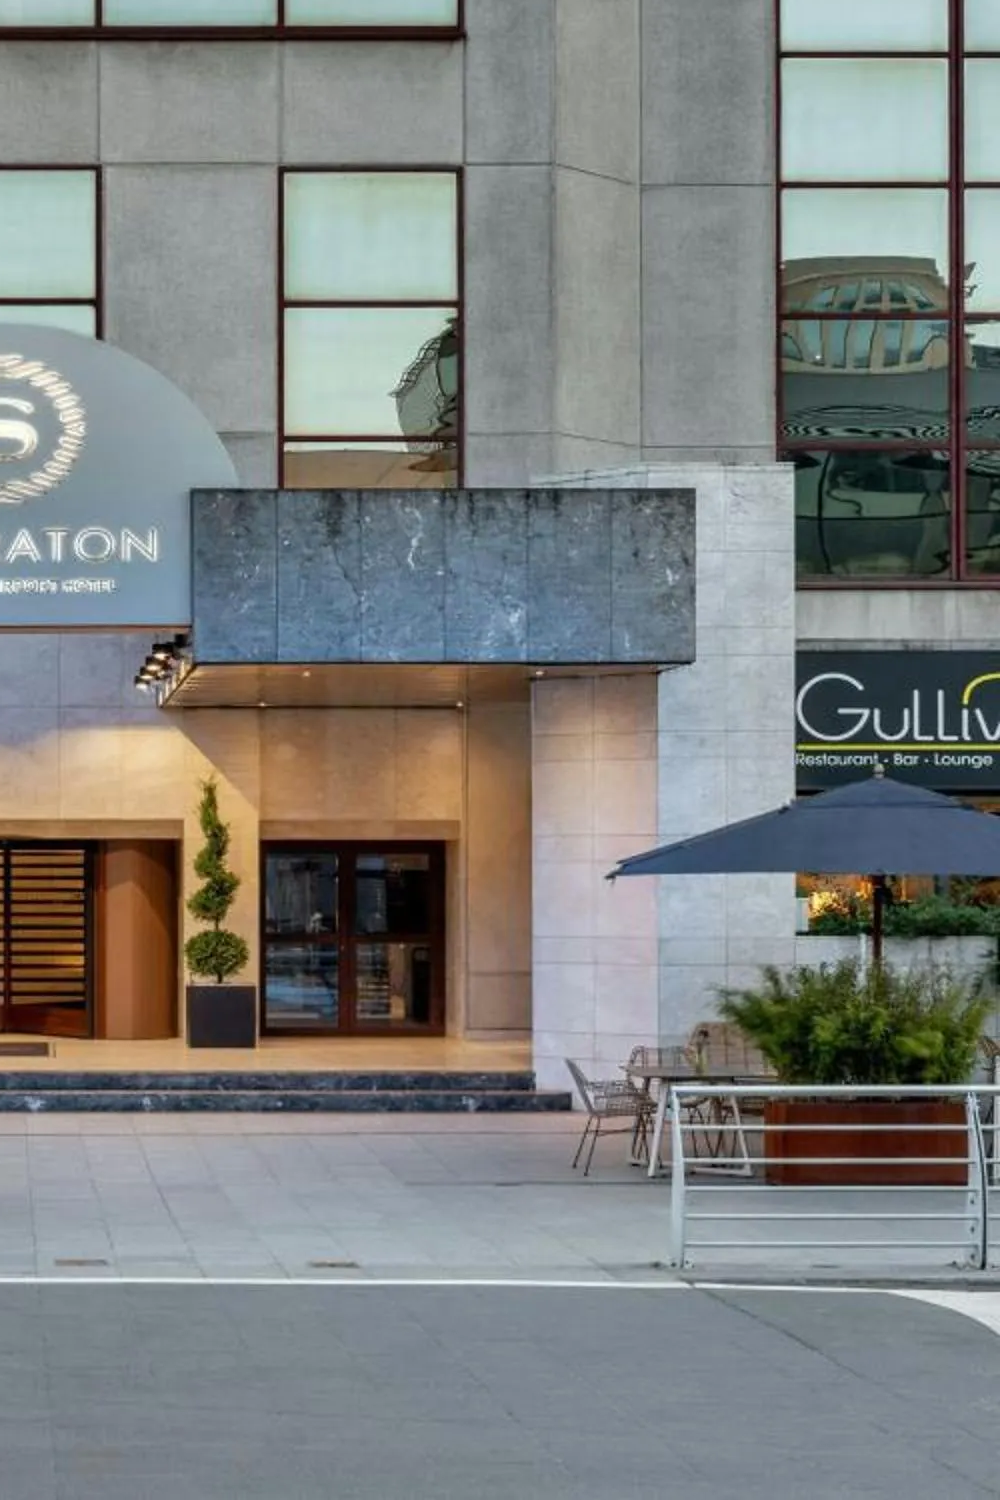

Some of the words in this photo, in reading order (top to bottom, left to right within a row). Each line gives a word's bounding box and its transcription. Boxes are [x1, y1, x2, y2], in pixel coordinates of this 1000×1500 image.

[795, 753, 880, 766] Restaurant
[893, 753, 920, 766] Bar
[933, 752, 994, 769] Lounge
